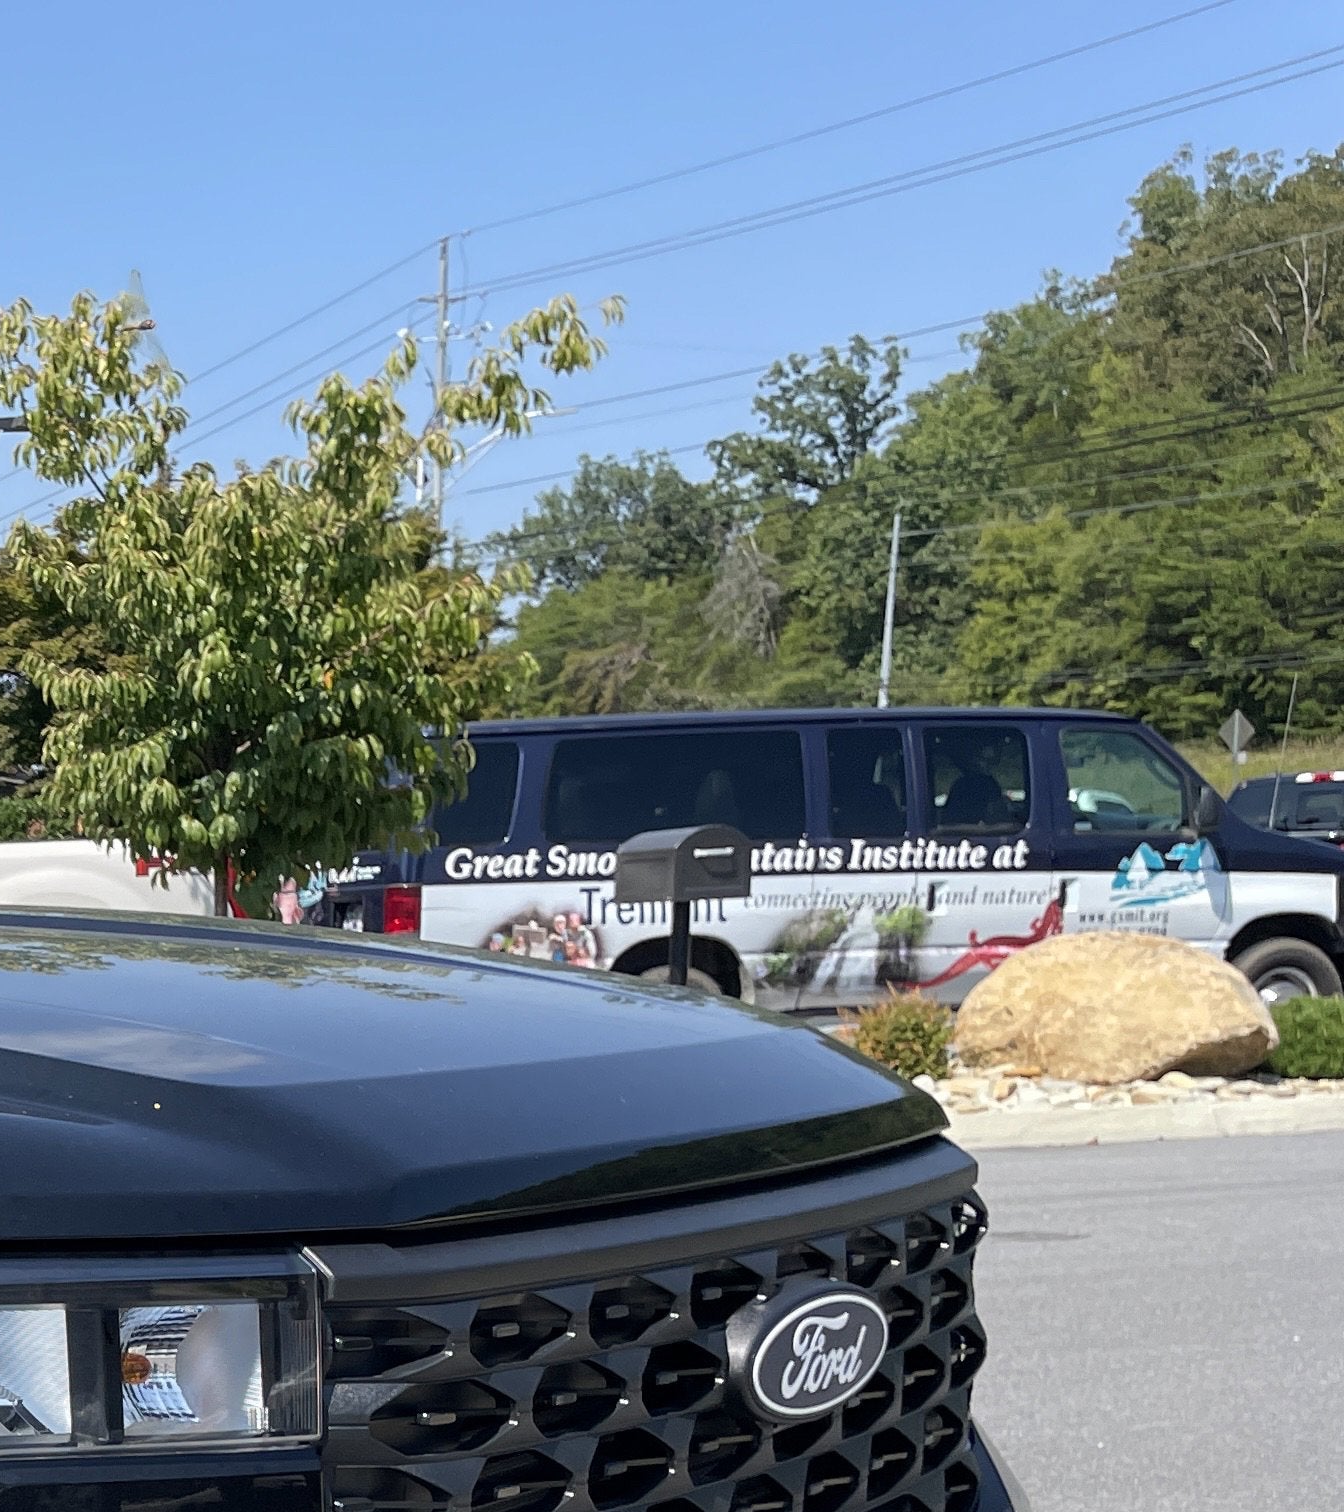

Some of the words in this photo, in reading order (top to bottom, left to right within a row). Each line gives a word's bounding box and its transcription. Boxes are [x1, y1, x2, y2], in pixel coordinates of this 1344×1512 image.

[444, 847, 542, 880] Great
[545, 844, 617, 878] Smo
[846, 838, 987, 872] Institute
[992, 838, 1030, 870] at
[579, 887, 727, 926] Tremnt
[780, 1311, 867, 1401] Ford
